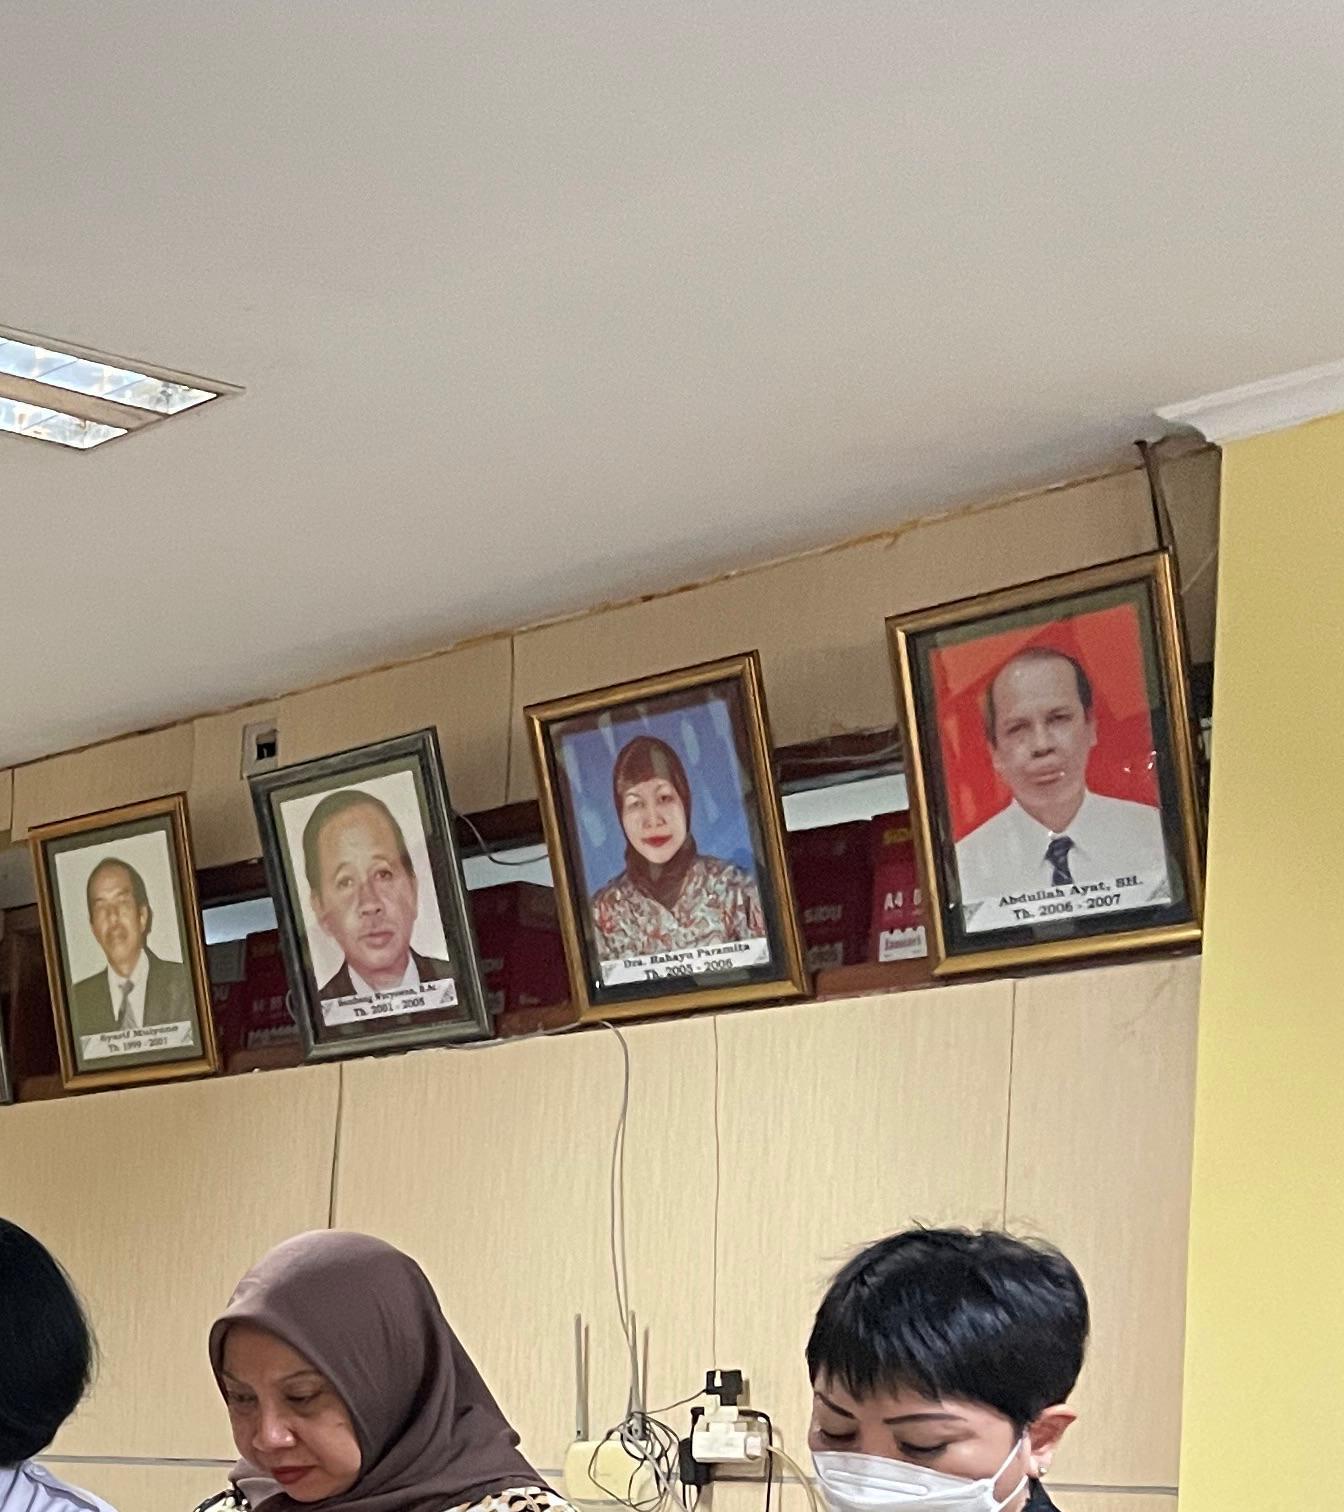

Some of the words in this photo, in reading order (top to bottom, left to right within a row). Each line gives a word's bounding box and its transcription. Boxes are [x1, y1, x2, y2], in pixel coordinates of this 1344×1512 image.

[998, 888, 1066, 907] Abdullah
[1070, 881, 1111, 897] Ayat,
[1115, 875, 1144, 888] SH.
[1039, 900, 1074, 916] 2006
[1087, 893, 1122, 909] 2007
[696, 943, 751, 959] Paramita
